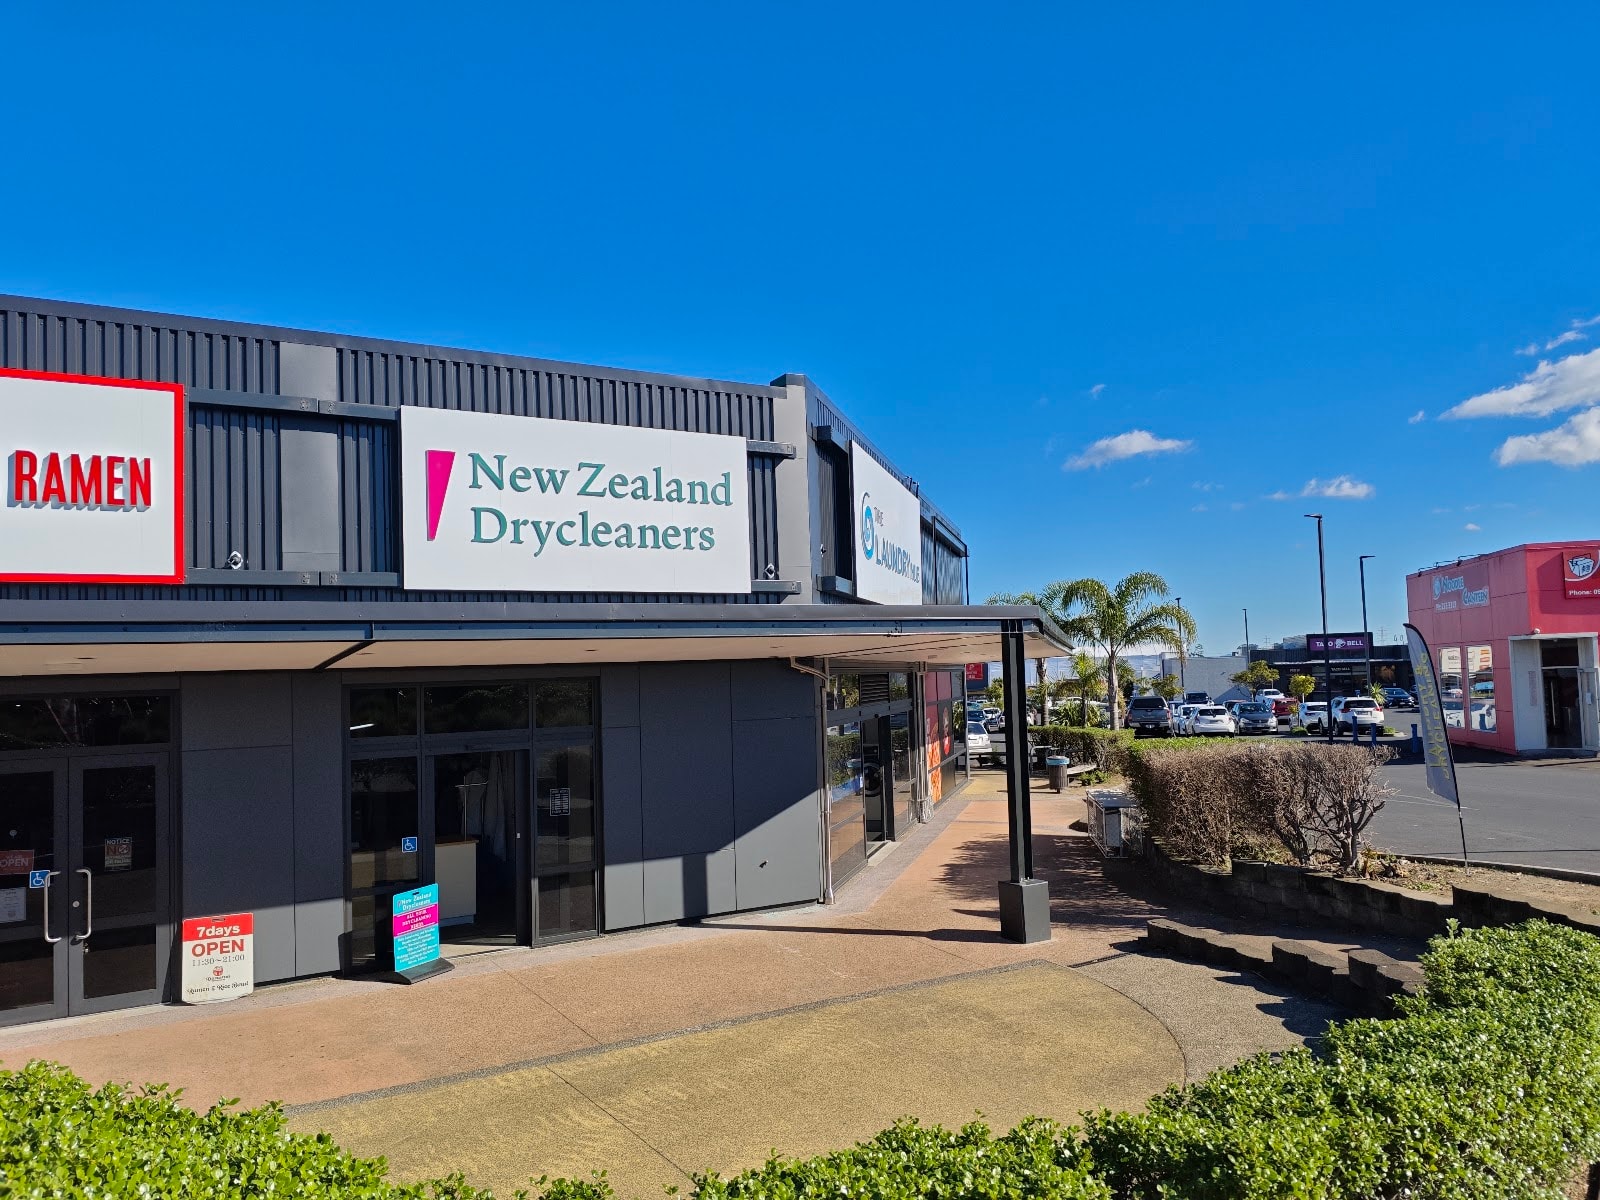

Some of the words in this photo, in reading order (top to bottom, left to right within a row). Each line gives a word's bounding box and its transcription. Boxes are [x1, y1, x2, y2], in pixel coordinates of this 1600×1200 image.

[10, 450, 151, 510] RAMEN
[468, 452, 570, 495] New
[577, 462, 734, 507] Zealand
[470, 506, 716, 557] Drycleaners
[873, 506, 885, 527] THE
[875, 534, 911, 579] LAUNDRY
[0, 857, 29, 868] OPEN
[196, 925, 241, 938] 7days
[191, 939, 245, 958] OPEN
